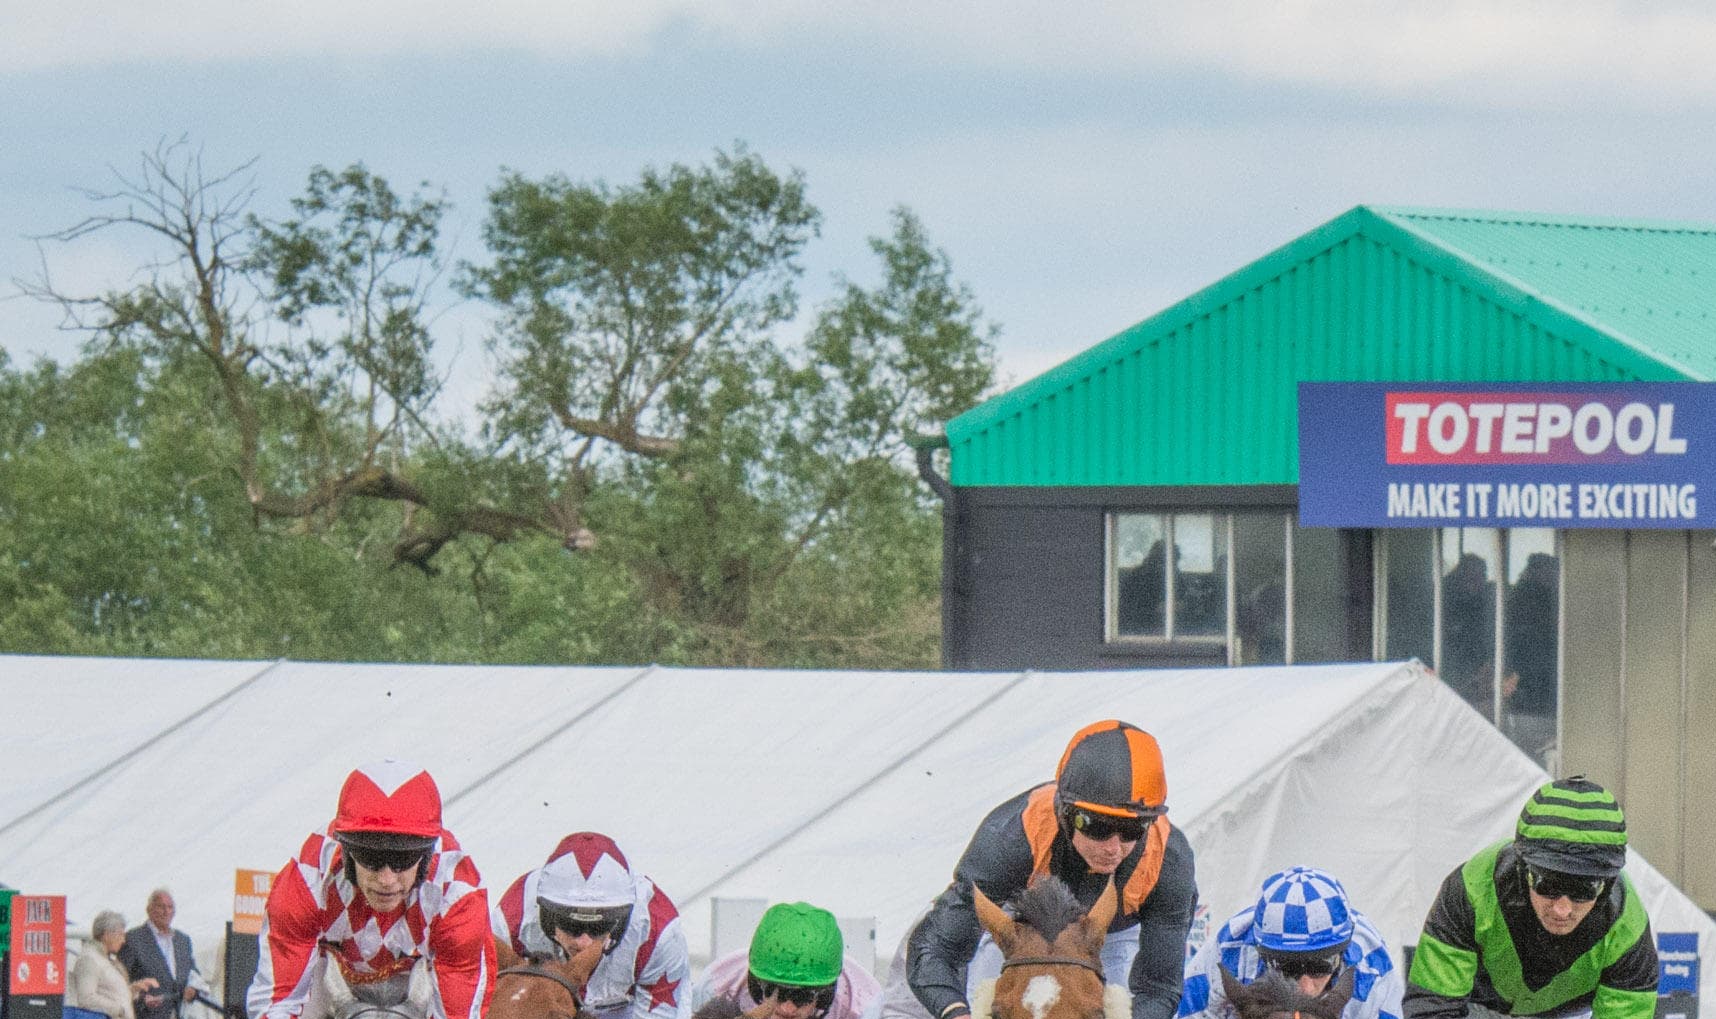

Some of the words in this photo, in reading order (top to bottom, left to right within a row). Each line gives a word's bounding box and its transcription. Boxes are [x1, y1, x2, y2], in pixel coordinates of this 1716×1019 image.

[1394, 402, 1687, 455] TOTEPOOL
[1387, 484, 1461, 519] MAKE
[1466, 484, 1493, 518] IT
[1497, 484, 1573, 519] MORE
[1578, 484, 1697, 520] EXCITING
